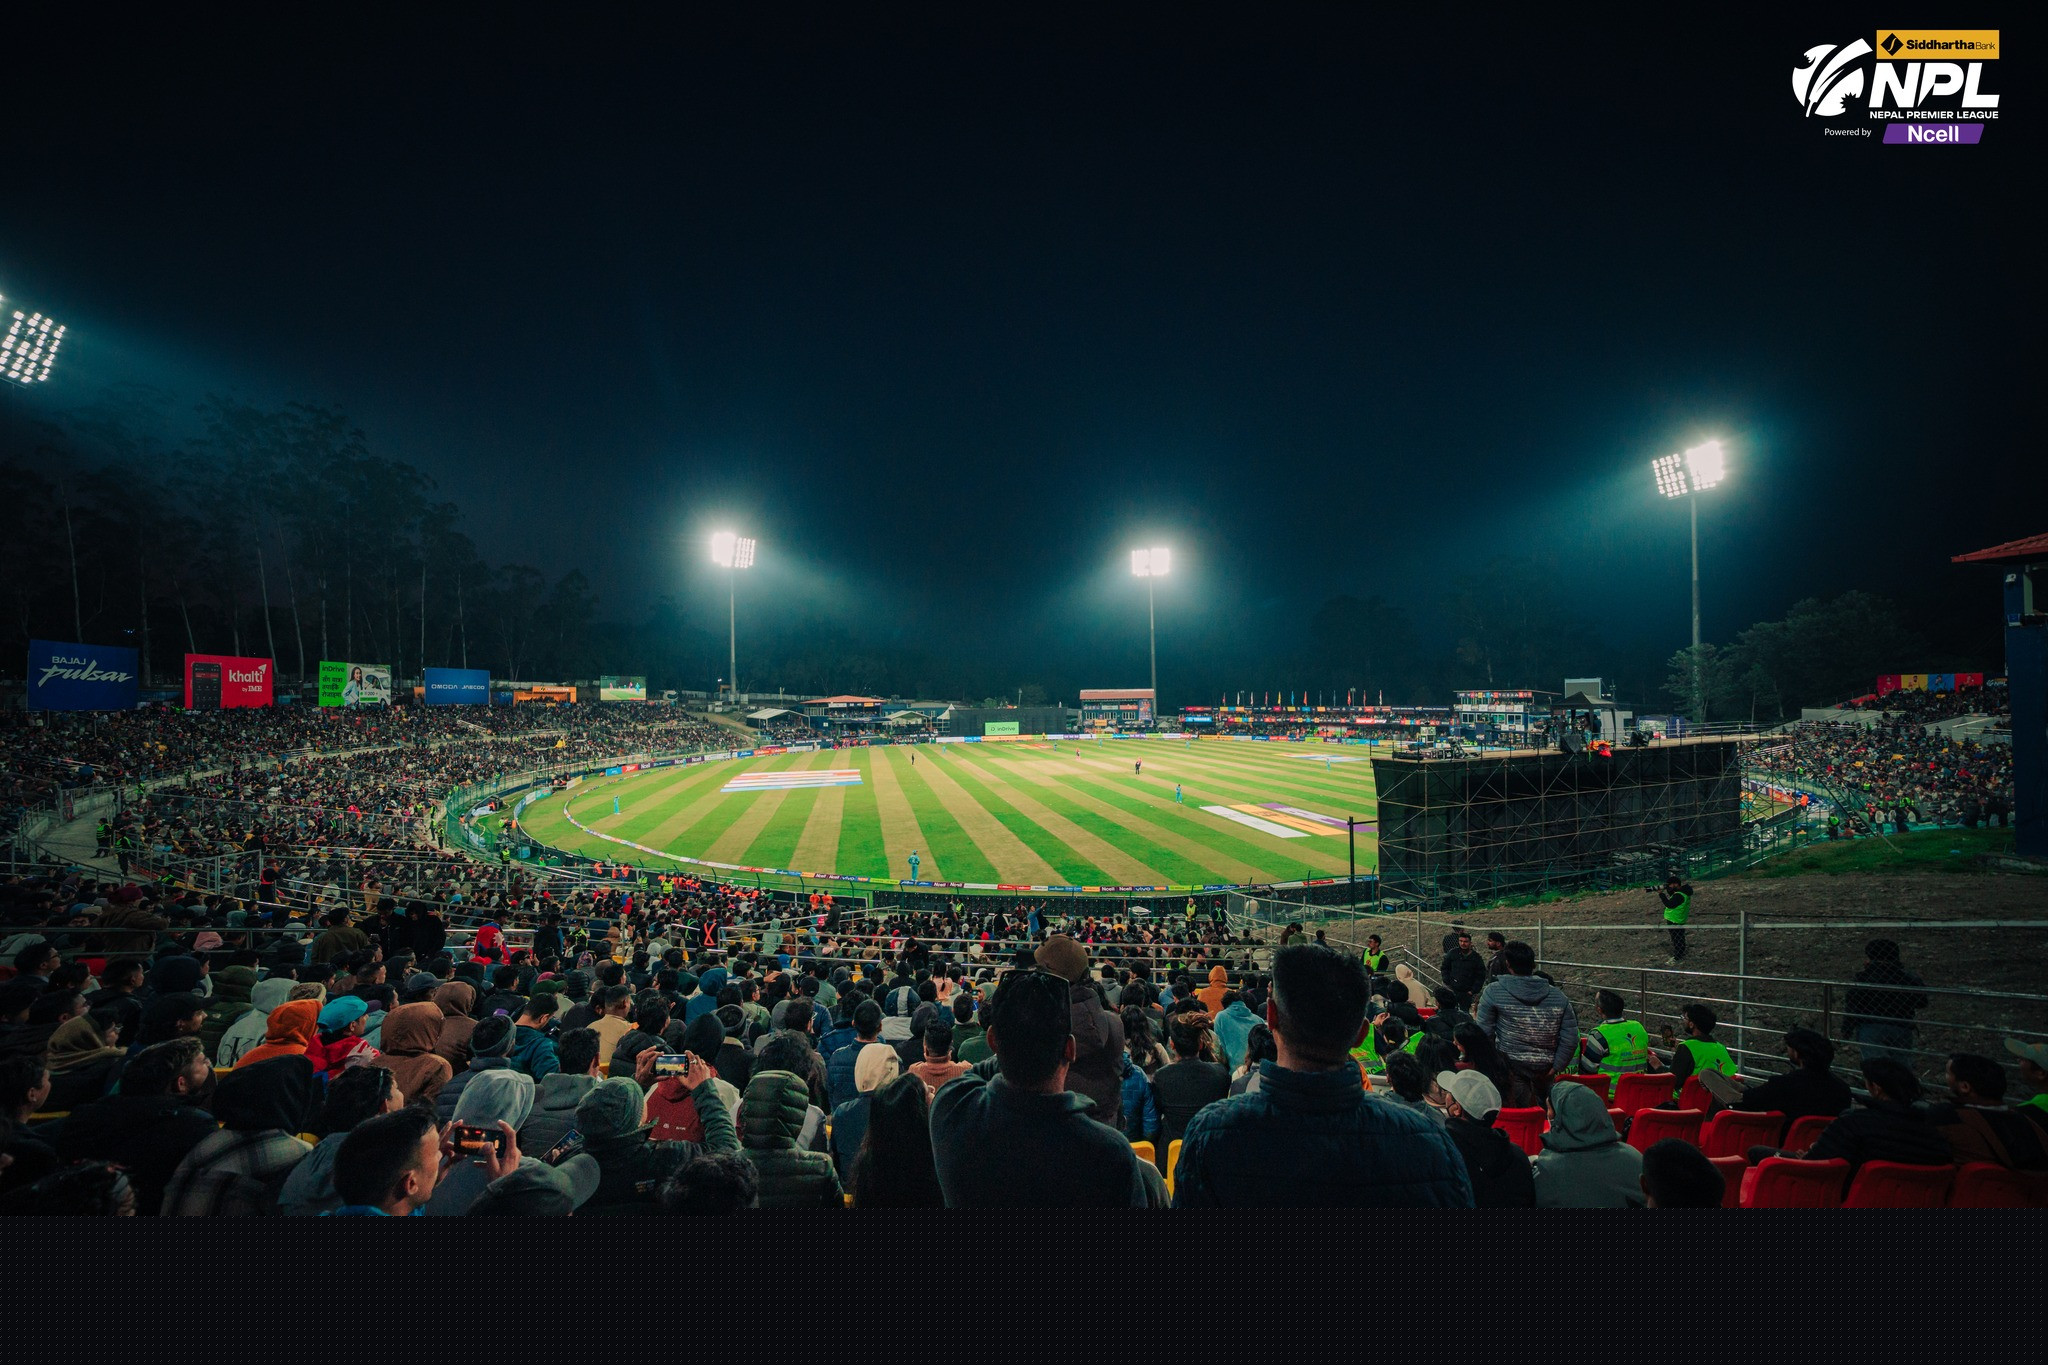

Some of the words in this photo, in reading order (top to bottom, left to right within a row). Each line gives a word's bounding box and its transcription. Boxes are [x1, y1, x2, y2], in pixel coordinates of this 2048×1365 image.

[51, 656, 87, 665] BAJAJ
[322, 665, 345, 673] inDrive
[228, 669, 263, 683] khalti
